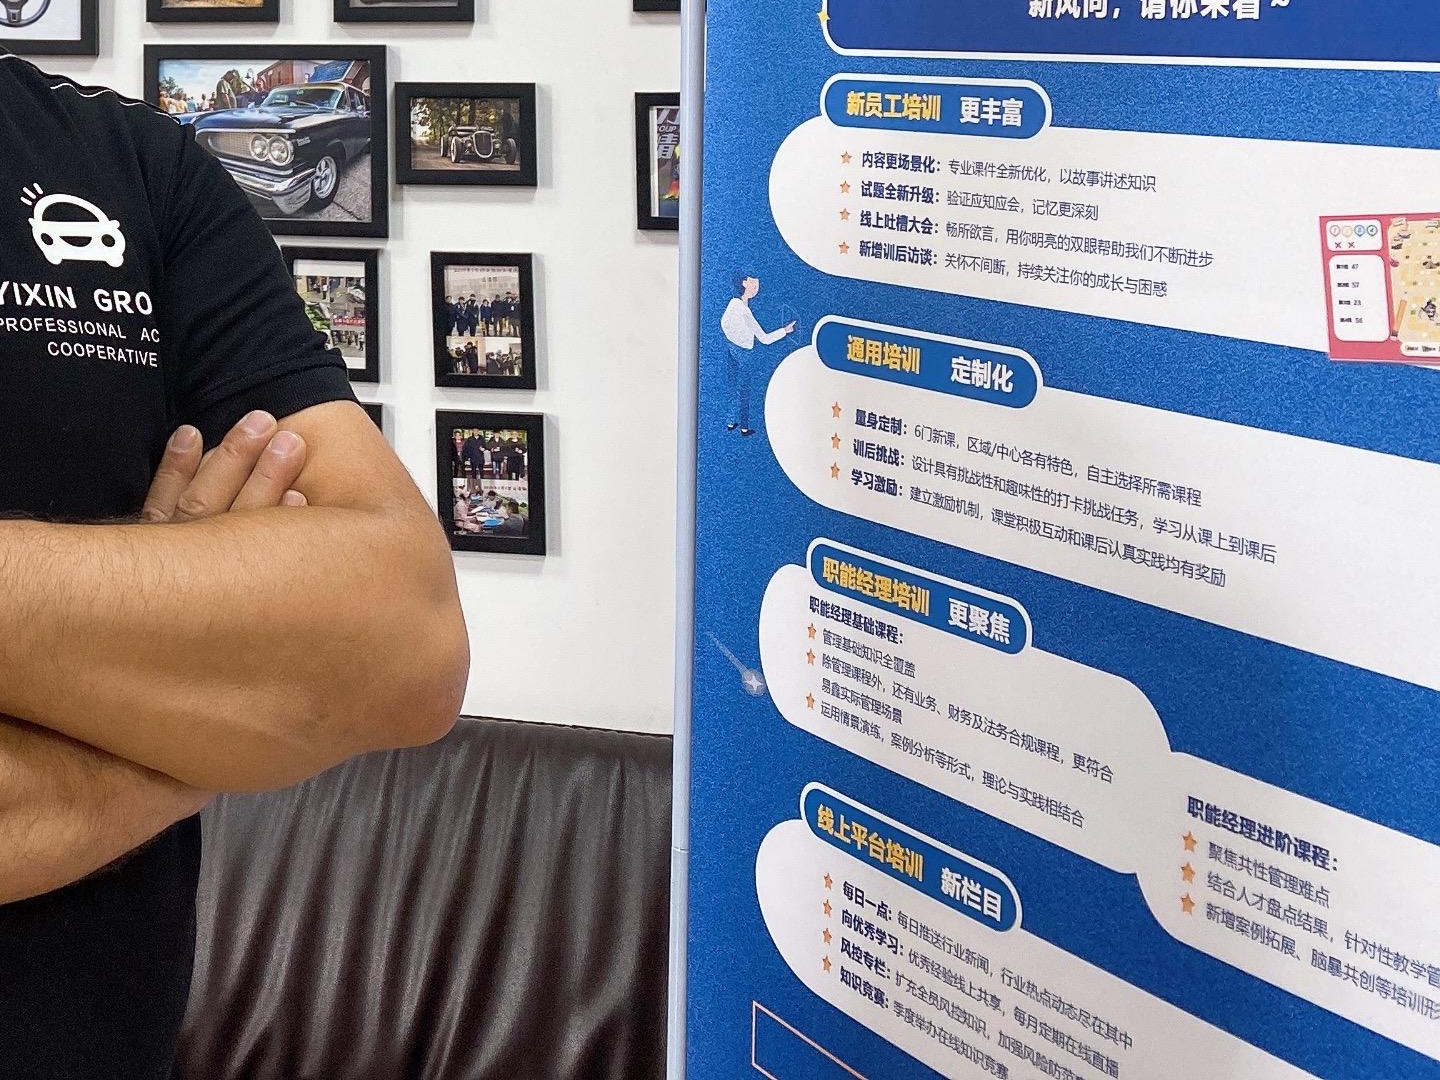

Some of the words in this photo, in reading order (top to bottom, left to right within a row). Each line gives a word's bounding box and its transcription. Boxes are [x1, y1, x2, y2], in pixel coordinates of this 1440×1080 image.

[657, 124, 677, 133] OUP
[846, 91, 942, 122] 新员工培训
[959, 96, 1024, 127] 更丰富
[93, 288, 153, 316] GRO
[47, 341, 158, 368] COOPERATIVE
[846, 334, 921, 375] 通用培训
[950, 356, 1014, 393] 定制化
[822, 556, 930, 617] 职能经理培训
[948, 598, 1011, 645] 更聚焦
[823, 628, 916, 678] 管理基础知识全覆盖
[821, 677, 903, 725] 易鑫实际管理场景
[817, 803, 924, 882] 线上平台培训
[940, 867, 1003, 922] 新栏目
[1208, 841, 1330, 909] 聚焦共性管理难点
